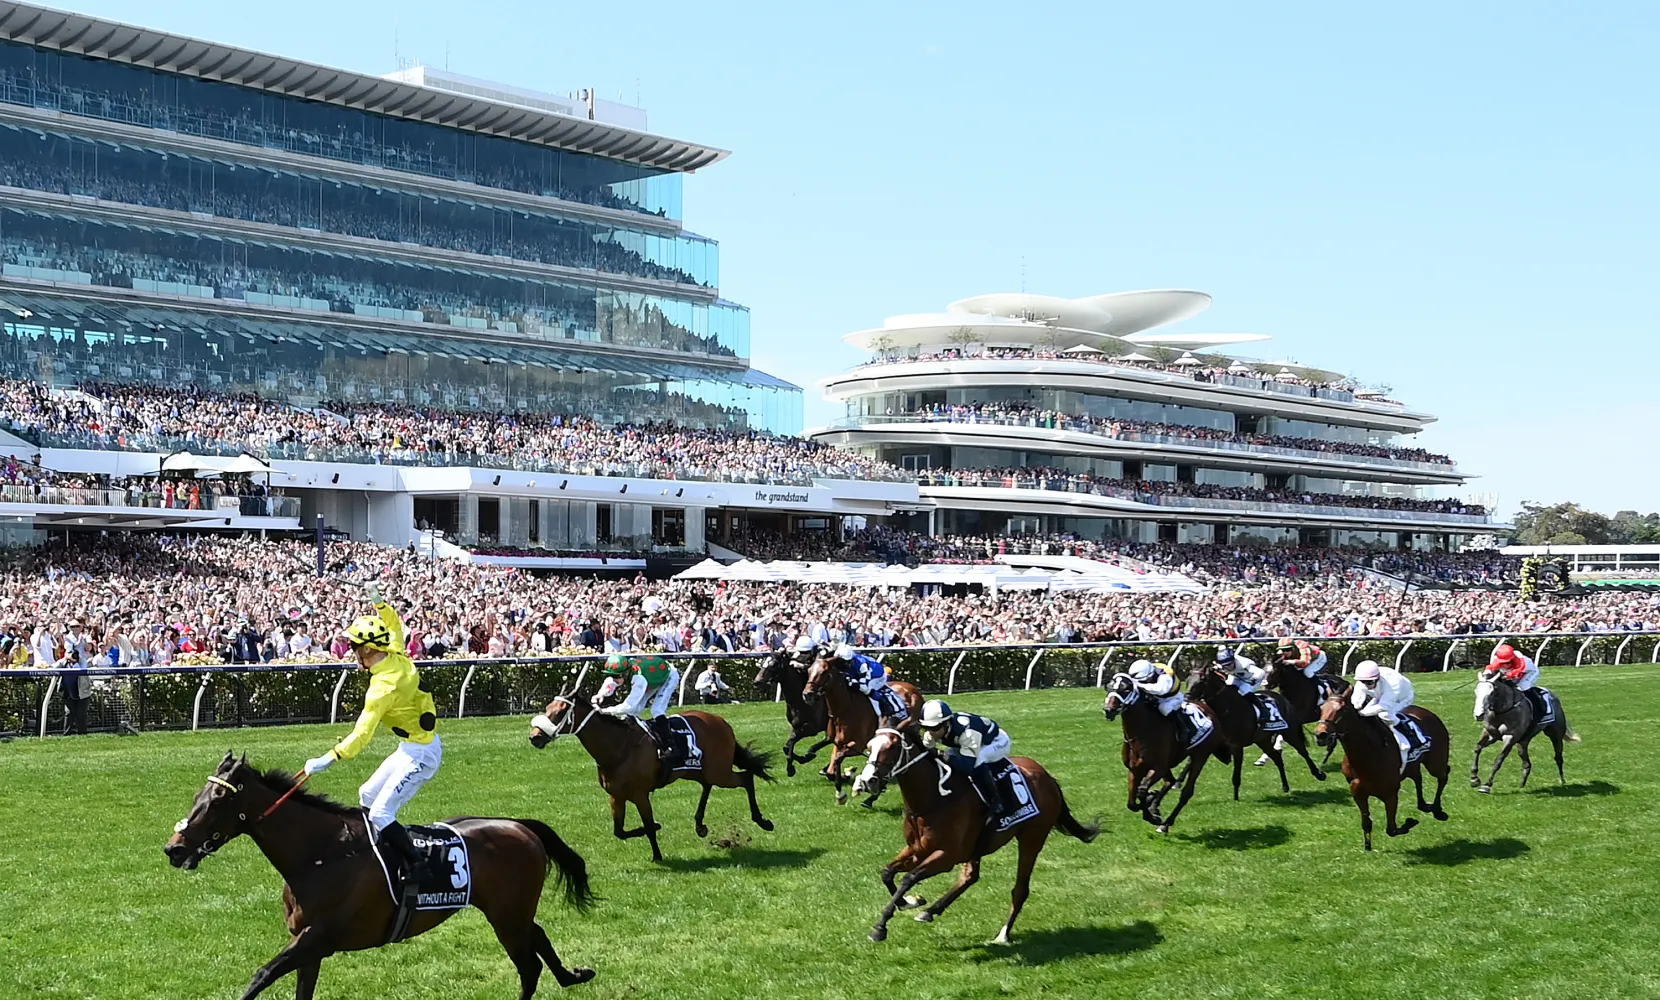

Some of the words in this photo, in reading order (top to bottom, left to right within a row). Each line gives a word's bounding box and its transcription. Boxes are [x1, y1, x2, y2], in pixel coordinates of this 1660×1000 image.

[755, 490, 767, 501] the
[768, 492, 809, 504] grandstand
[1009, 772, 1029, 805] 6
[447, 846, 468, 889] 3
[417, 892, 443, 905] WITHOUT
[448, 891, 467, 903] FIGHT
